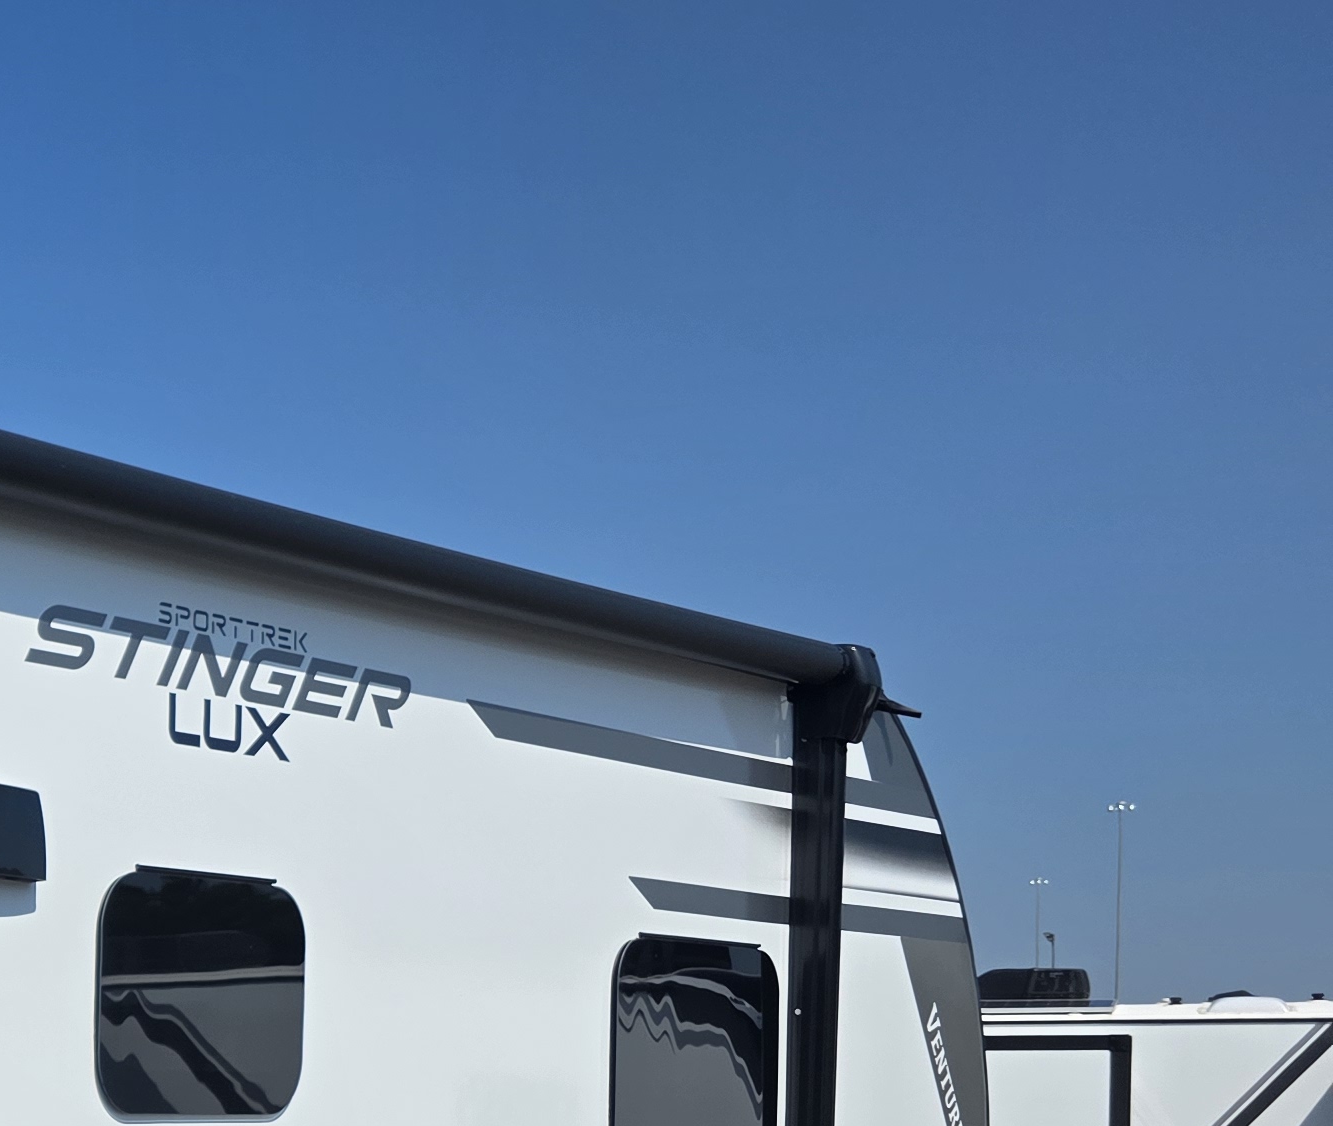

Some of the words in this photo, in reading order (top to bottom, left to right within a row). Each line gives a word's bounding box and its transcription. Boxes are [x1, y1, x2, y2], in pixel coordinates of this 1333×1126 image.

[158, 602, 308, 653] SPORTTREK
[24, 604, 412, 728] STINGER
[169, 692, 290, 762] LUX
